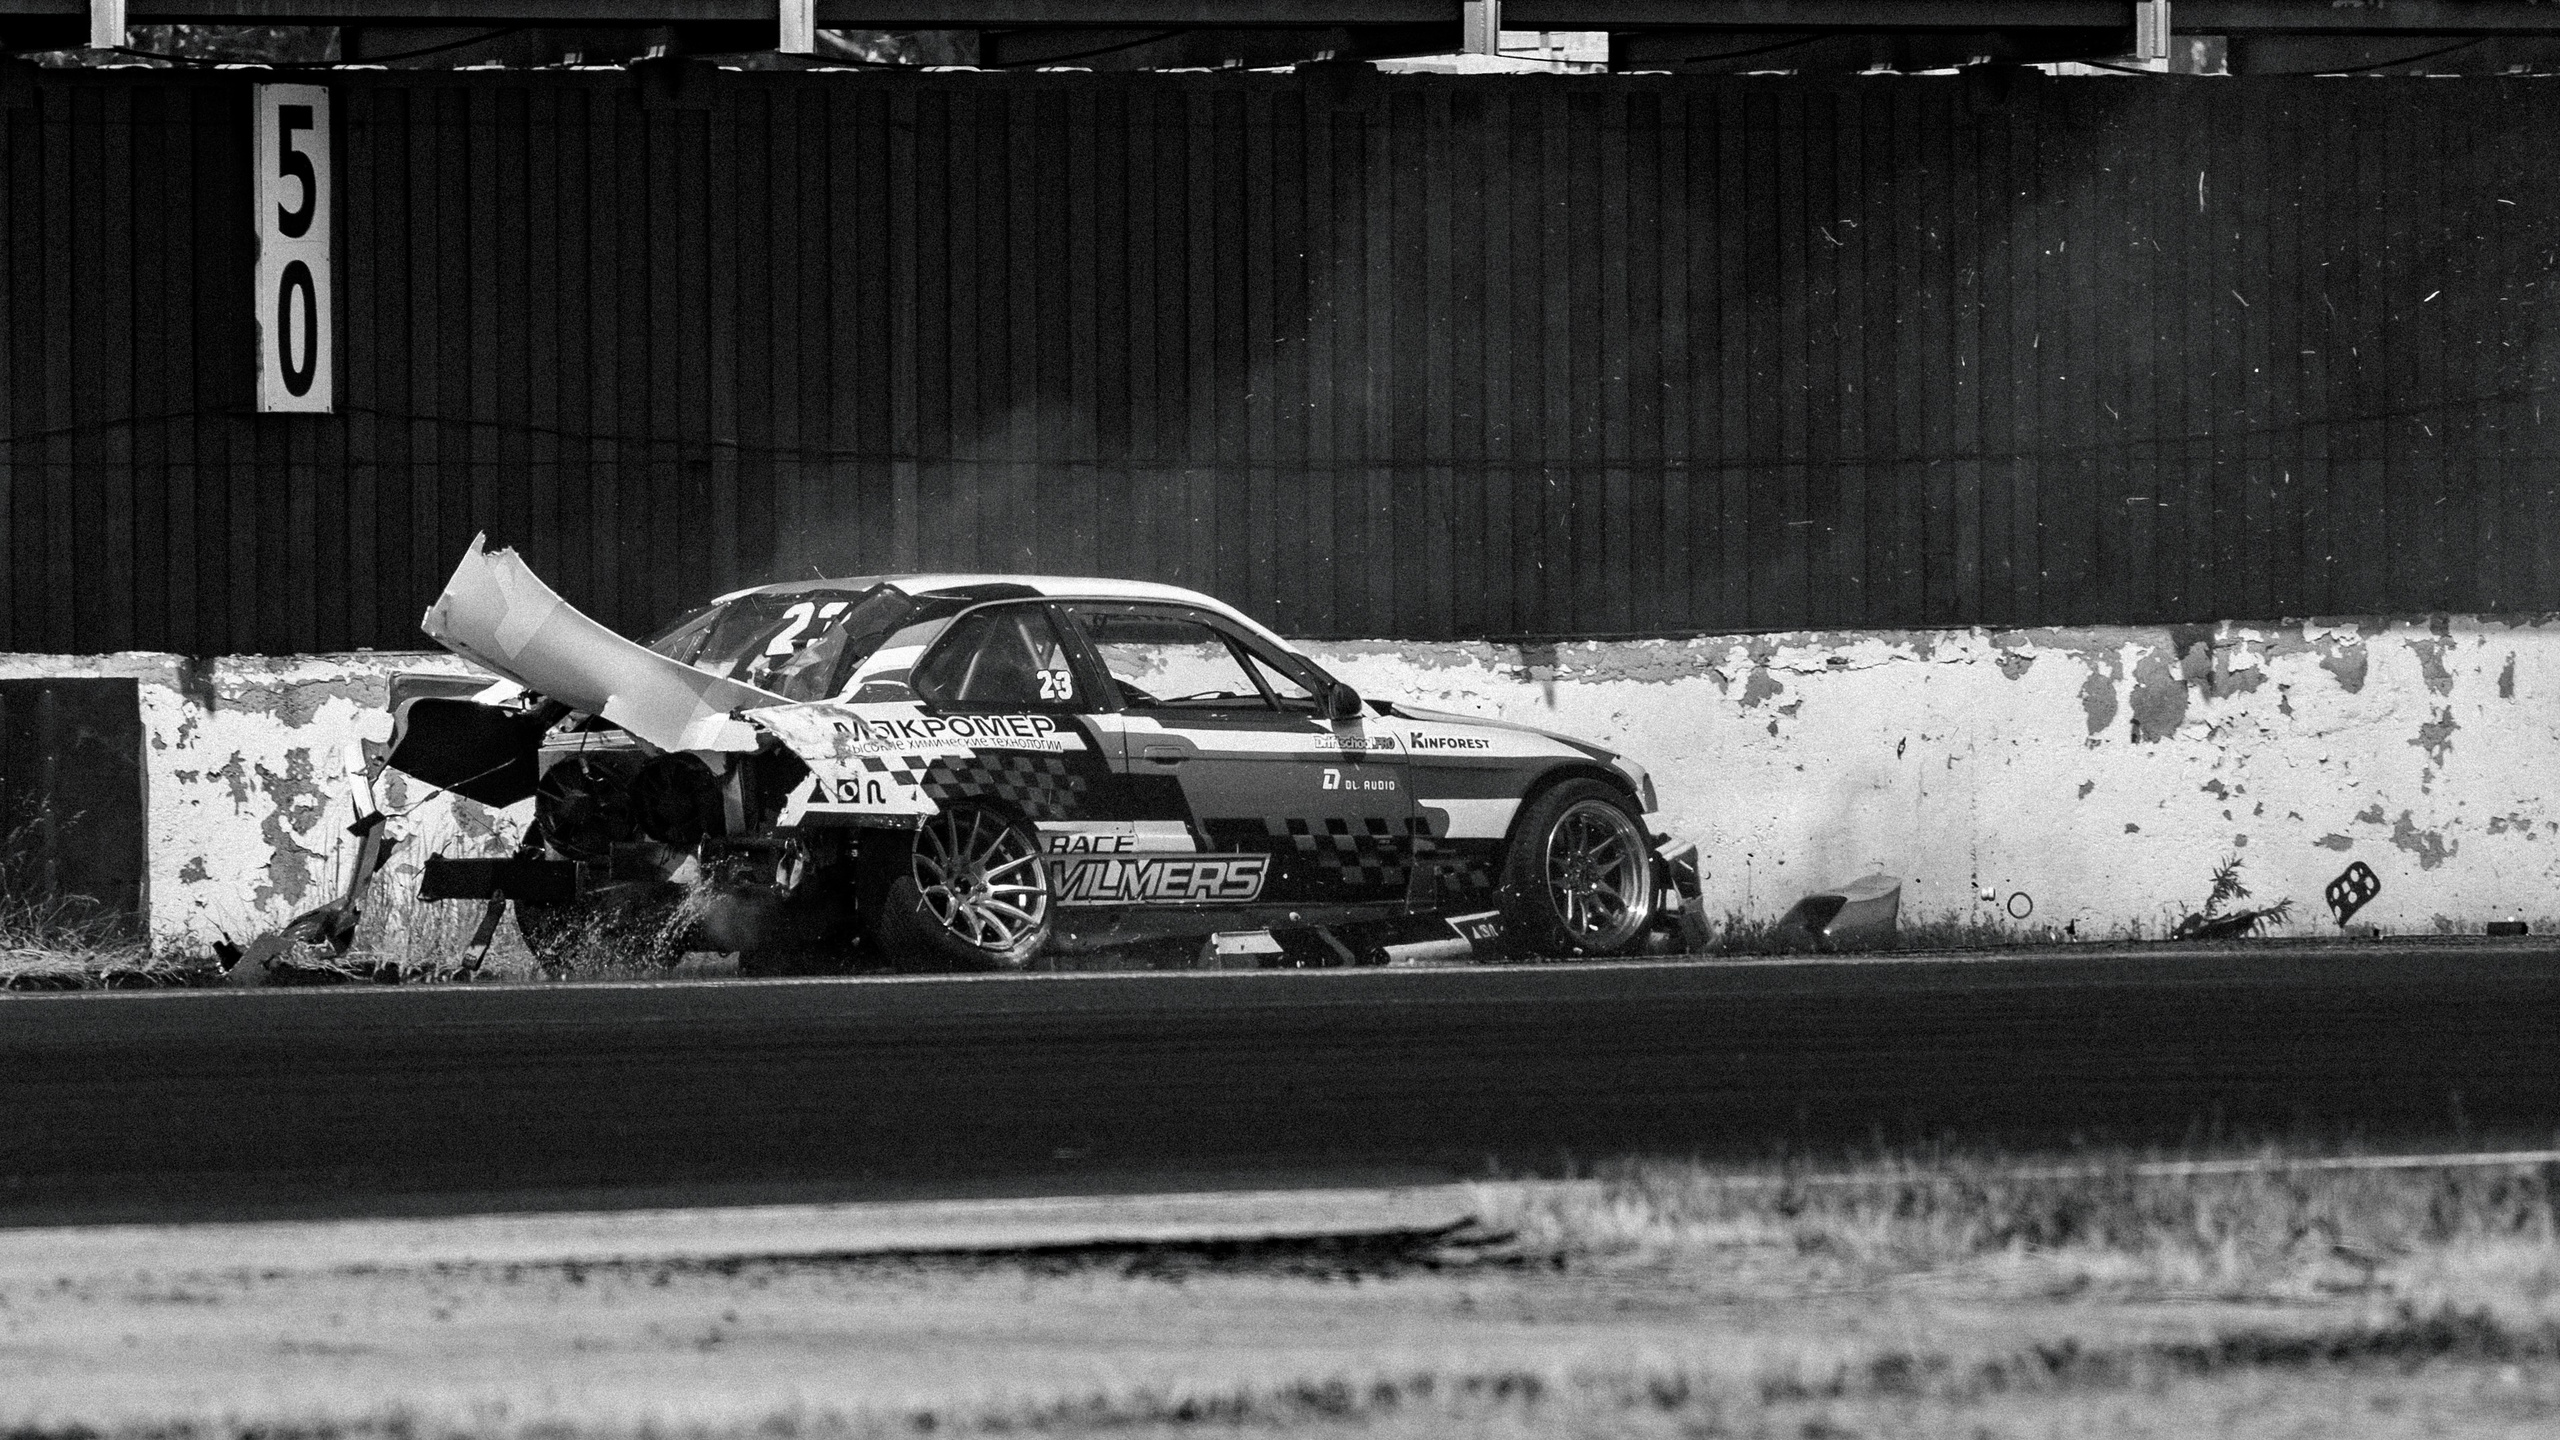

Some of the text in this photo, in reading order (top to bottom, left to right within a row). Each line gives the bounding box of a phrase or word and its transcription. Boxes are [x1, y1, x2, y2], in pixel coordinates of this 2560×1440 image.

[278, 104, 318, 398] 50
[1036, 669, 1073, 700] 23
[1363, 780, 1396, 791] AUDIO
[1048, 835, 1135, 854] RACE
[1050, 858, 1266, 901] VILMERS
